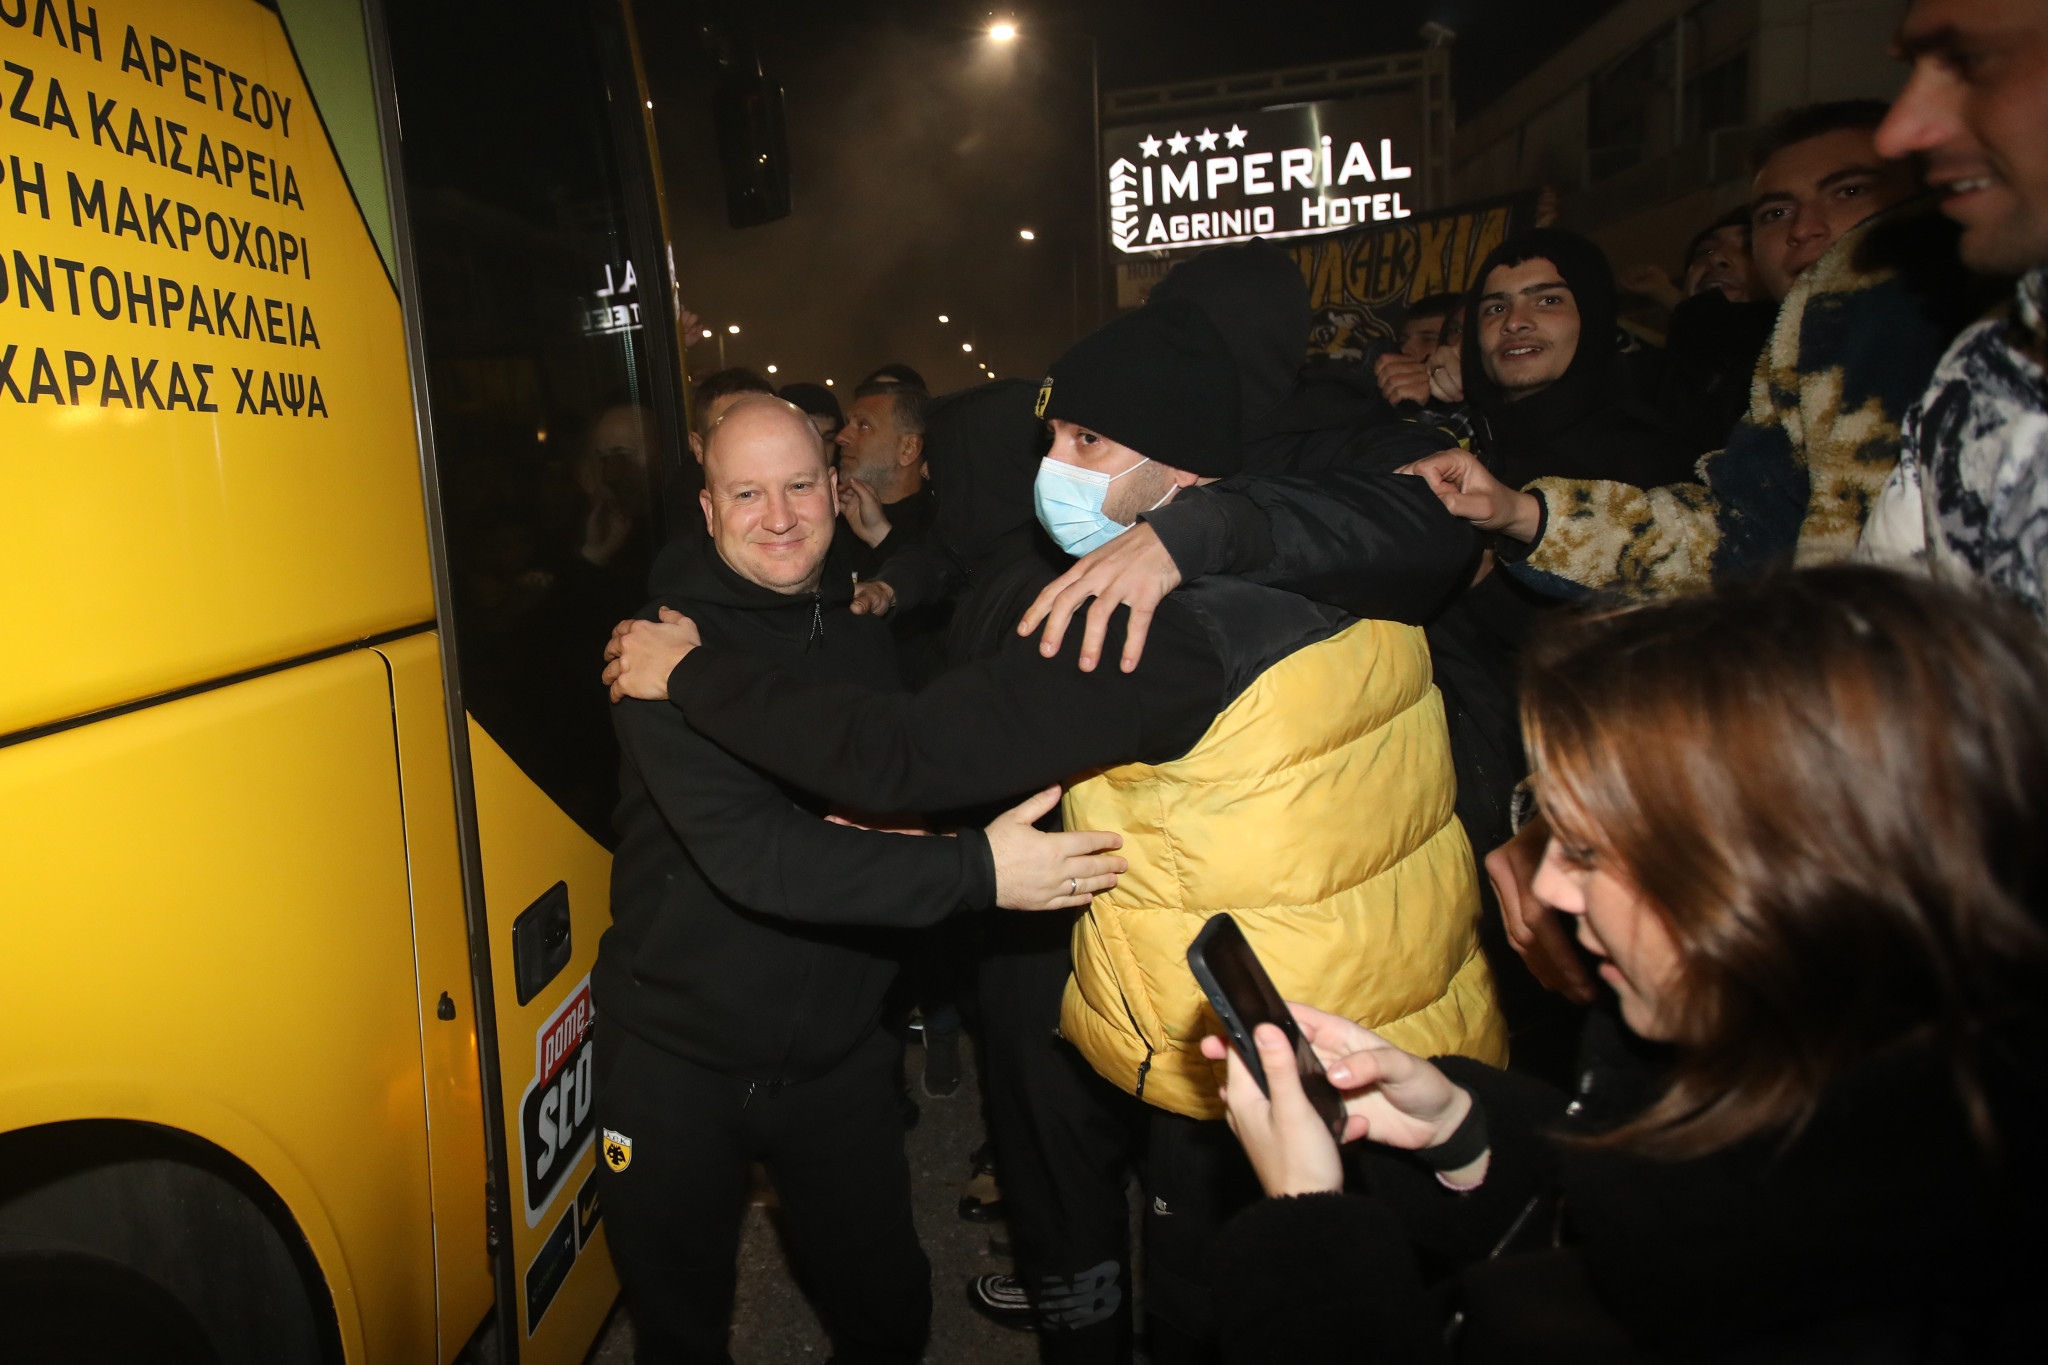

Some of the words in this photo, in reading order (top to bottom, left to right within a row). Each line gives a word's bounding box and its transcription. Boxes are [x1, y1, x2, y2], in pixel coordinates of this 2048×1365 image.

[121, 25, 291, 138] ΑΡΕΤΣΟΥ
[0, 60, 79, 139] ΖΑ
[87, 91, 304, 211] ΚΑΙΣΑΡΕΙΑ
[0, 155, 50, 220] Η
[67, 171, 310, 280] ΜΑΚΡΟΧΩΡΙ
[1146, 206, 1275, 243] AGRINIO
[1302, 192, 1412, 228] HOTEL
[0, 250, 321, 350] ΝΤΟΗΡΑΚΛΕΙΑ
[232, 368, 328, 418] ΧΑΨΑ
[544, 998, 586, 1080] pame
